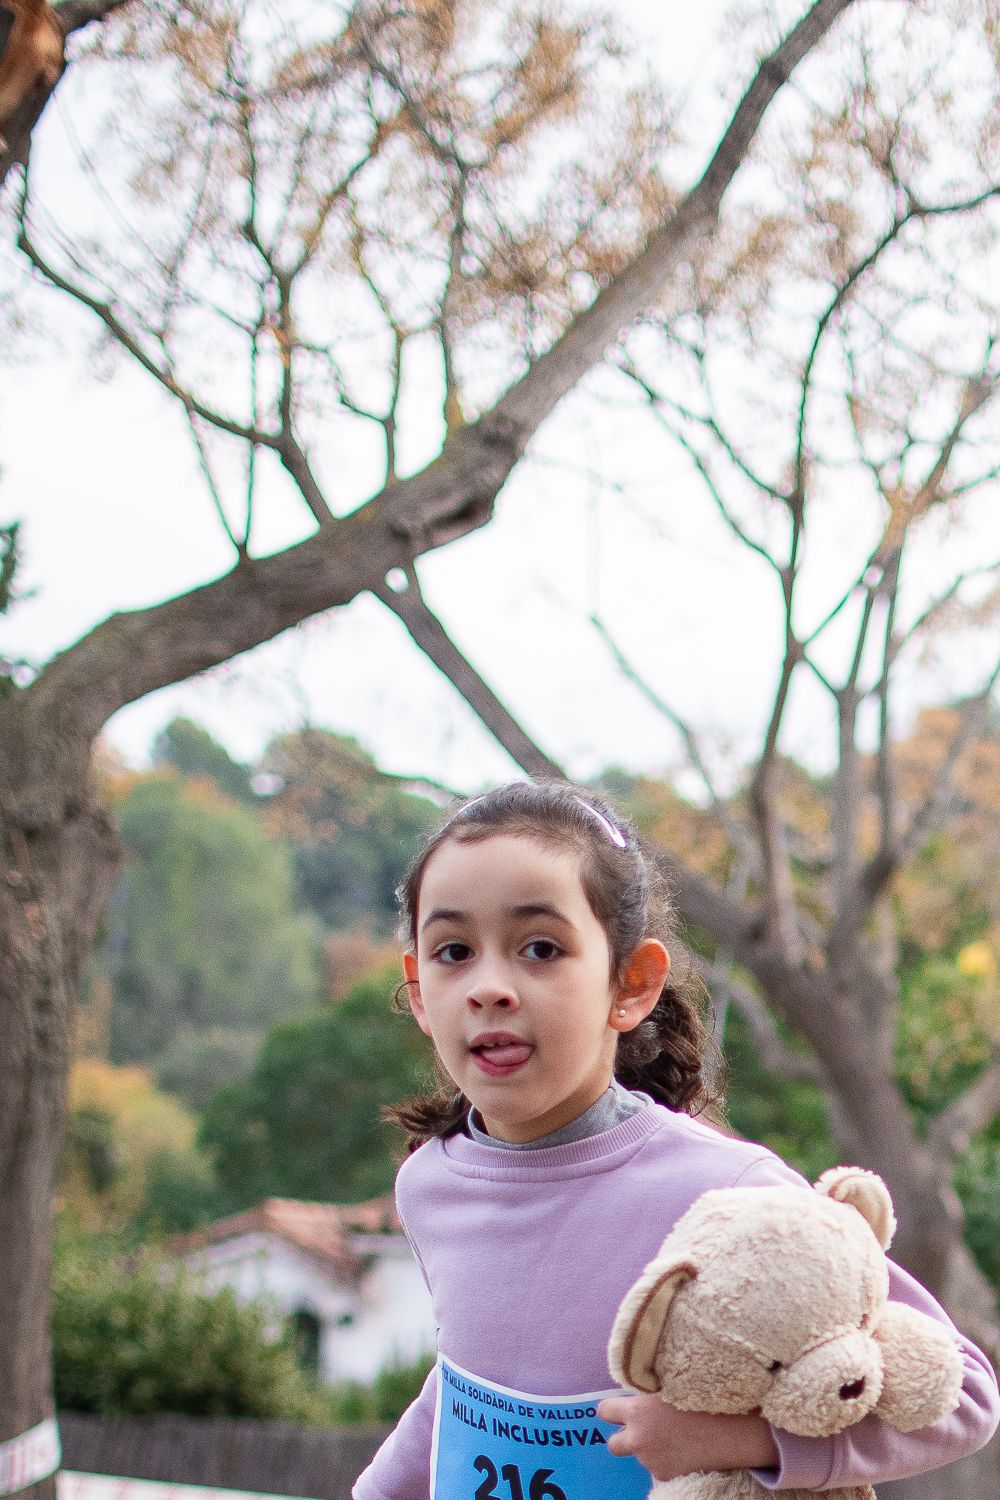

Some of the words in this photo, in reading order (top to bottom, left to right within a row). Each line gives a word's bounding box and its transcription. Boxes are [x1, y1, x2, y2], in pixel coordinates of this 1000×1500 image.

[468, 1384, 515, 1414] SOLIDÀRIA
[518, 1404, 535, 1418] DE
[453, 1398, 488, 1433] MILLA
[493, 1417, 607, 1447] INCLUSIVA
